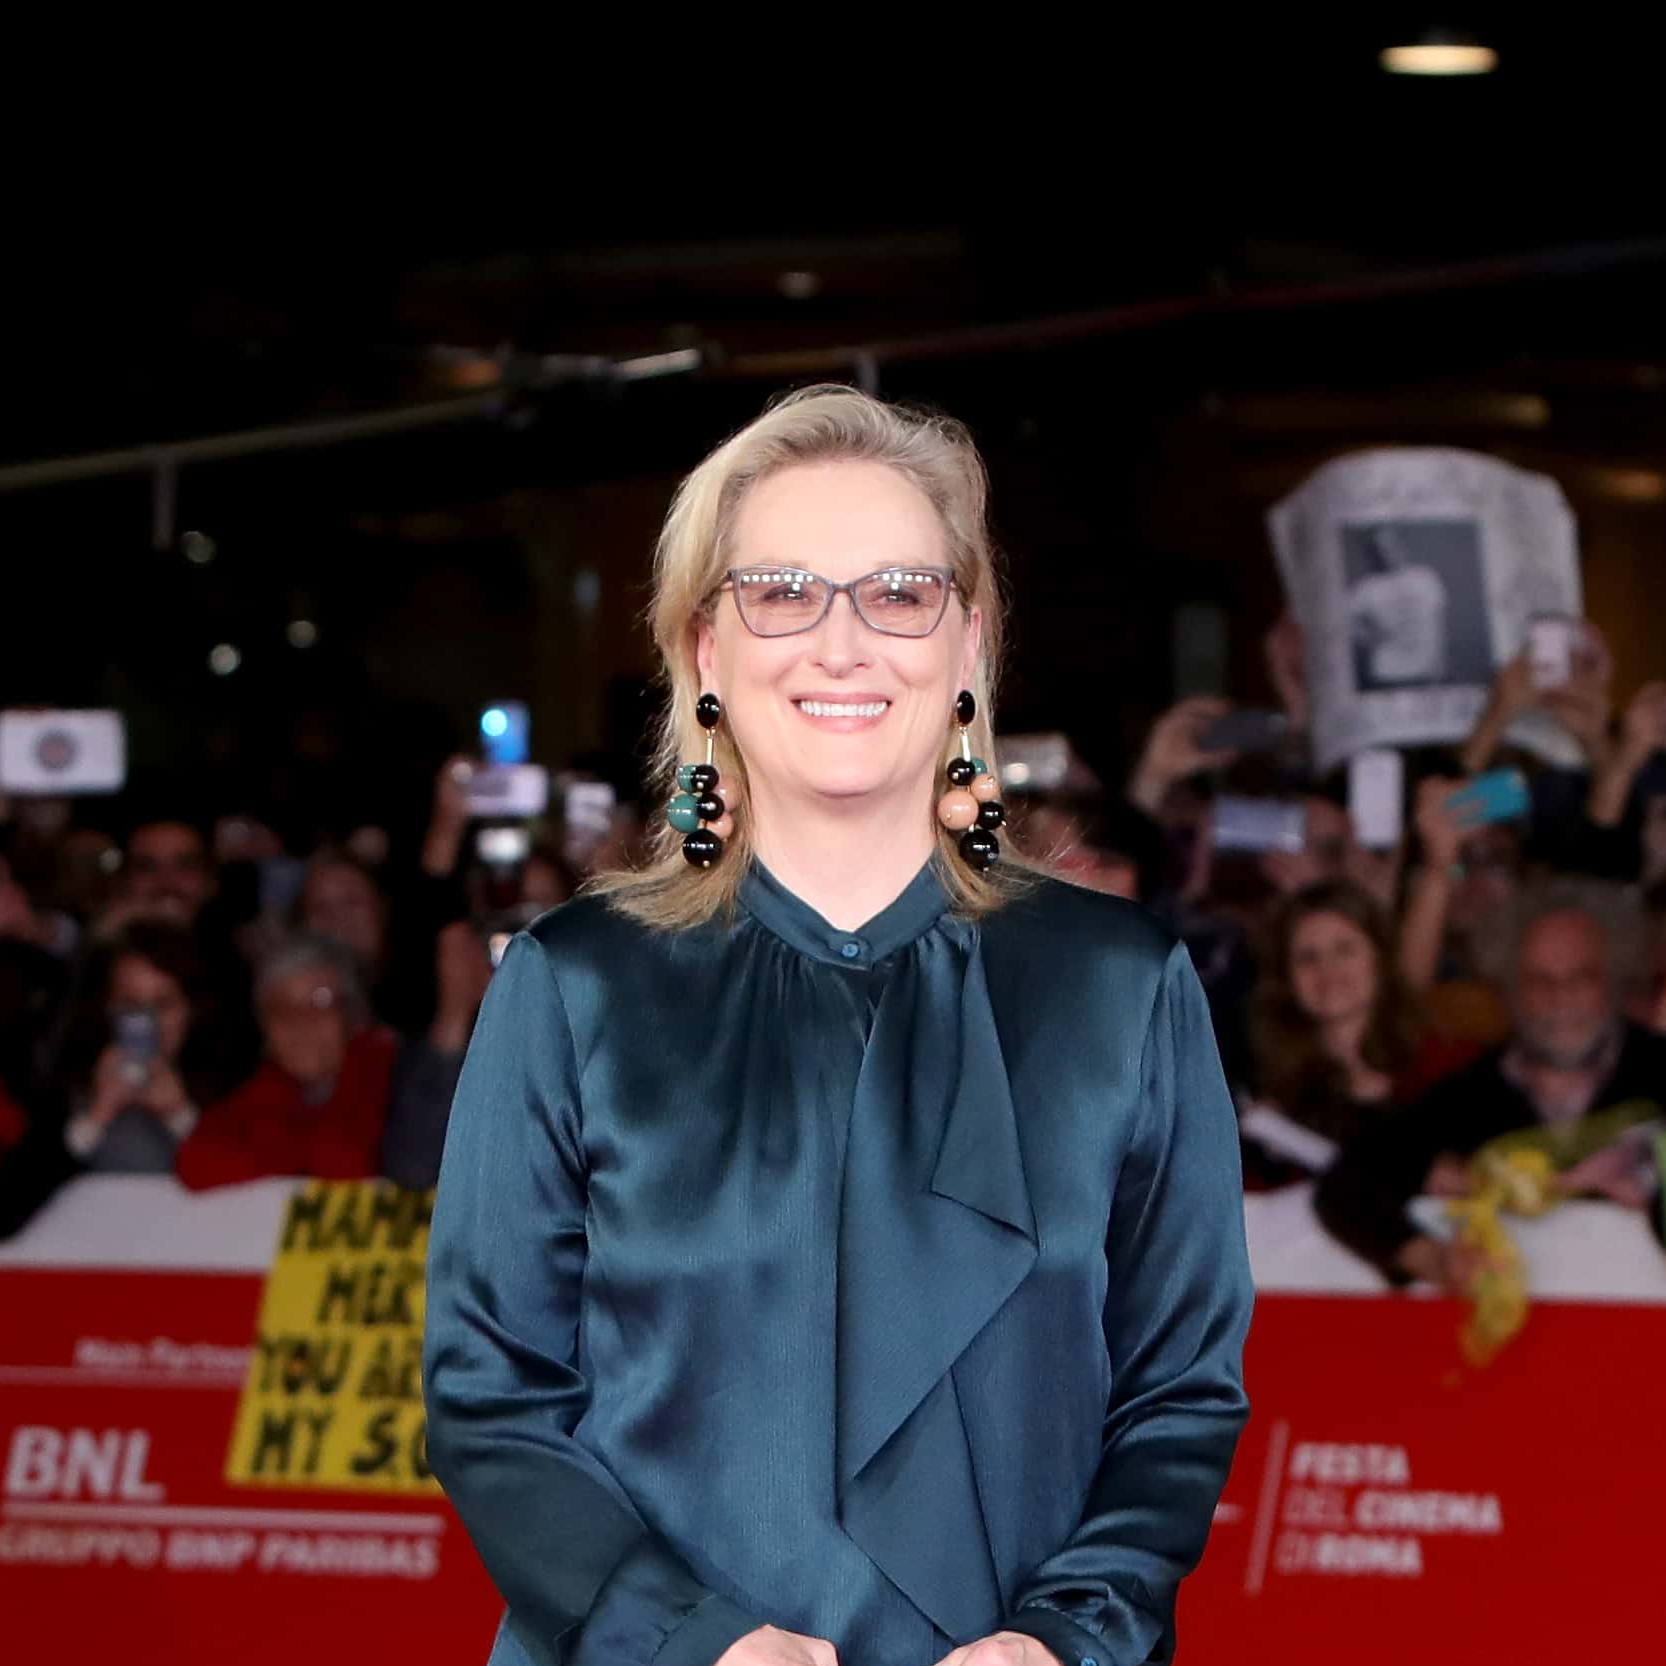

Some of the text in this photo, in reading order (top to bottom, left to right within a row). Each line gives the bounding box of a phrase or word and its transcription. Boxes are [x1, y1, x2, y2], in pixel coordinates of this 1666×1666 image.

[258, 1334, 354, 1397] YOU
[4, 1425, 164, 1501] BNL
[249, 1406, 334, 1475] MY
[1289, 1441, 1411, 1486] FESTA
[1354, 1490, 1504, 1537] CINEMA
[165, 1533, 255, 1572] BNP
[258, 1536, 438, 1580] PARIBAS
[1314, 1532, 1424, 1579] ROMA
